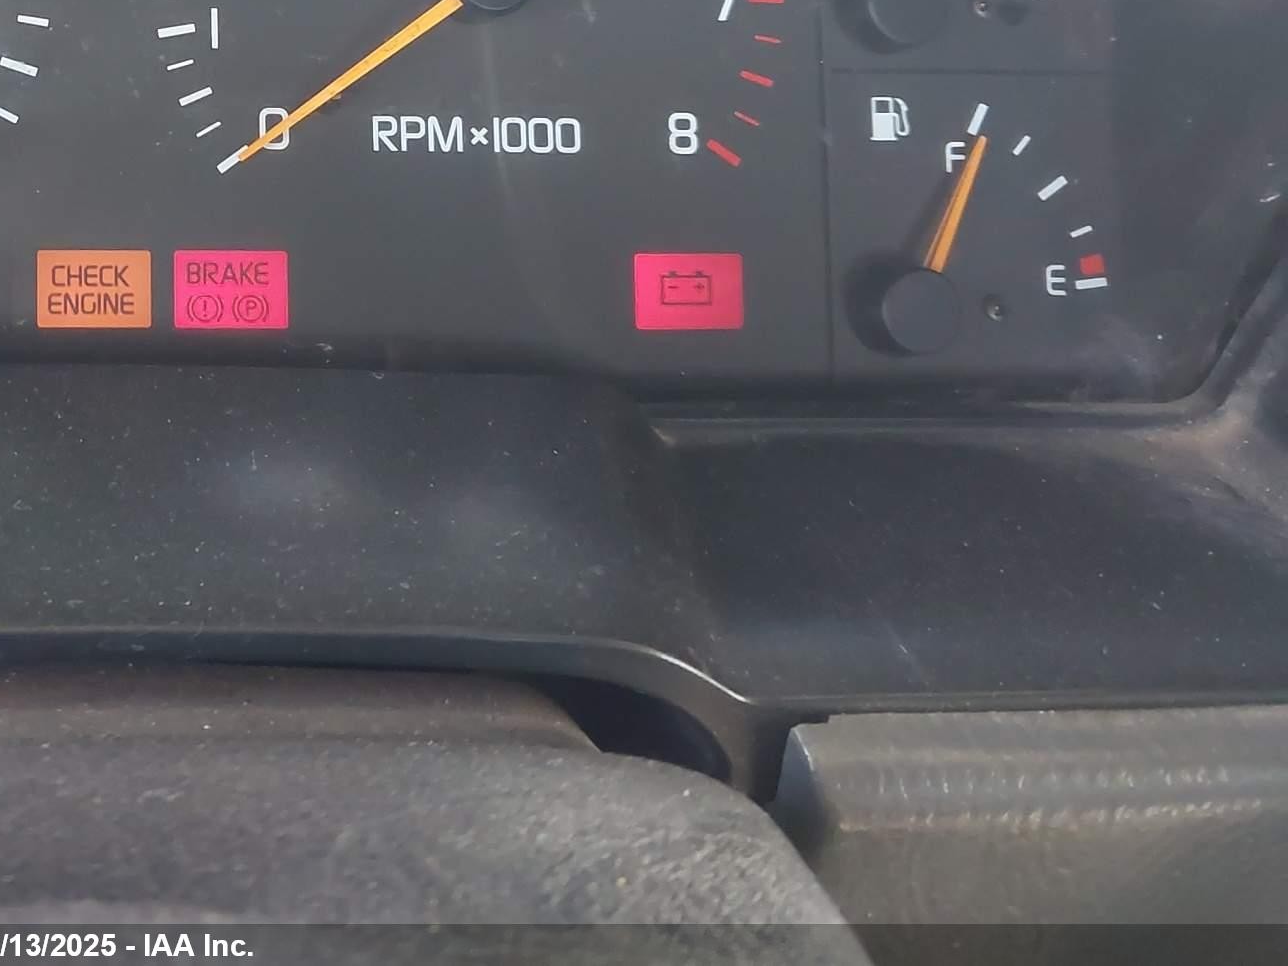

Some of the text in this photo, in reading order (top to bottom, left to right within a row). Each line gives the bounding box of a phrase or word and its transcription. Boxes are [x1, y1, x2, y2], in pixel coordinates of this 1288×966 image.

[210, 7, 219, 49] 1
[259, 106, 290, 152] 0
[668, 112, 698, 155] 8
[945, 141, 966, 173] F
[51, 265, 130, 288] CHECK
[186, 261, 270, 286] BRAKE
[1045, 264, 1067, 296] E
[47, 292, 135, 315] ENGINE
